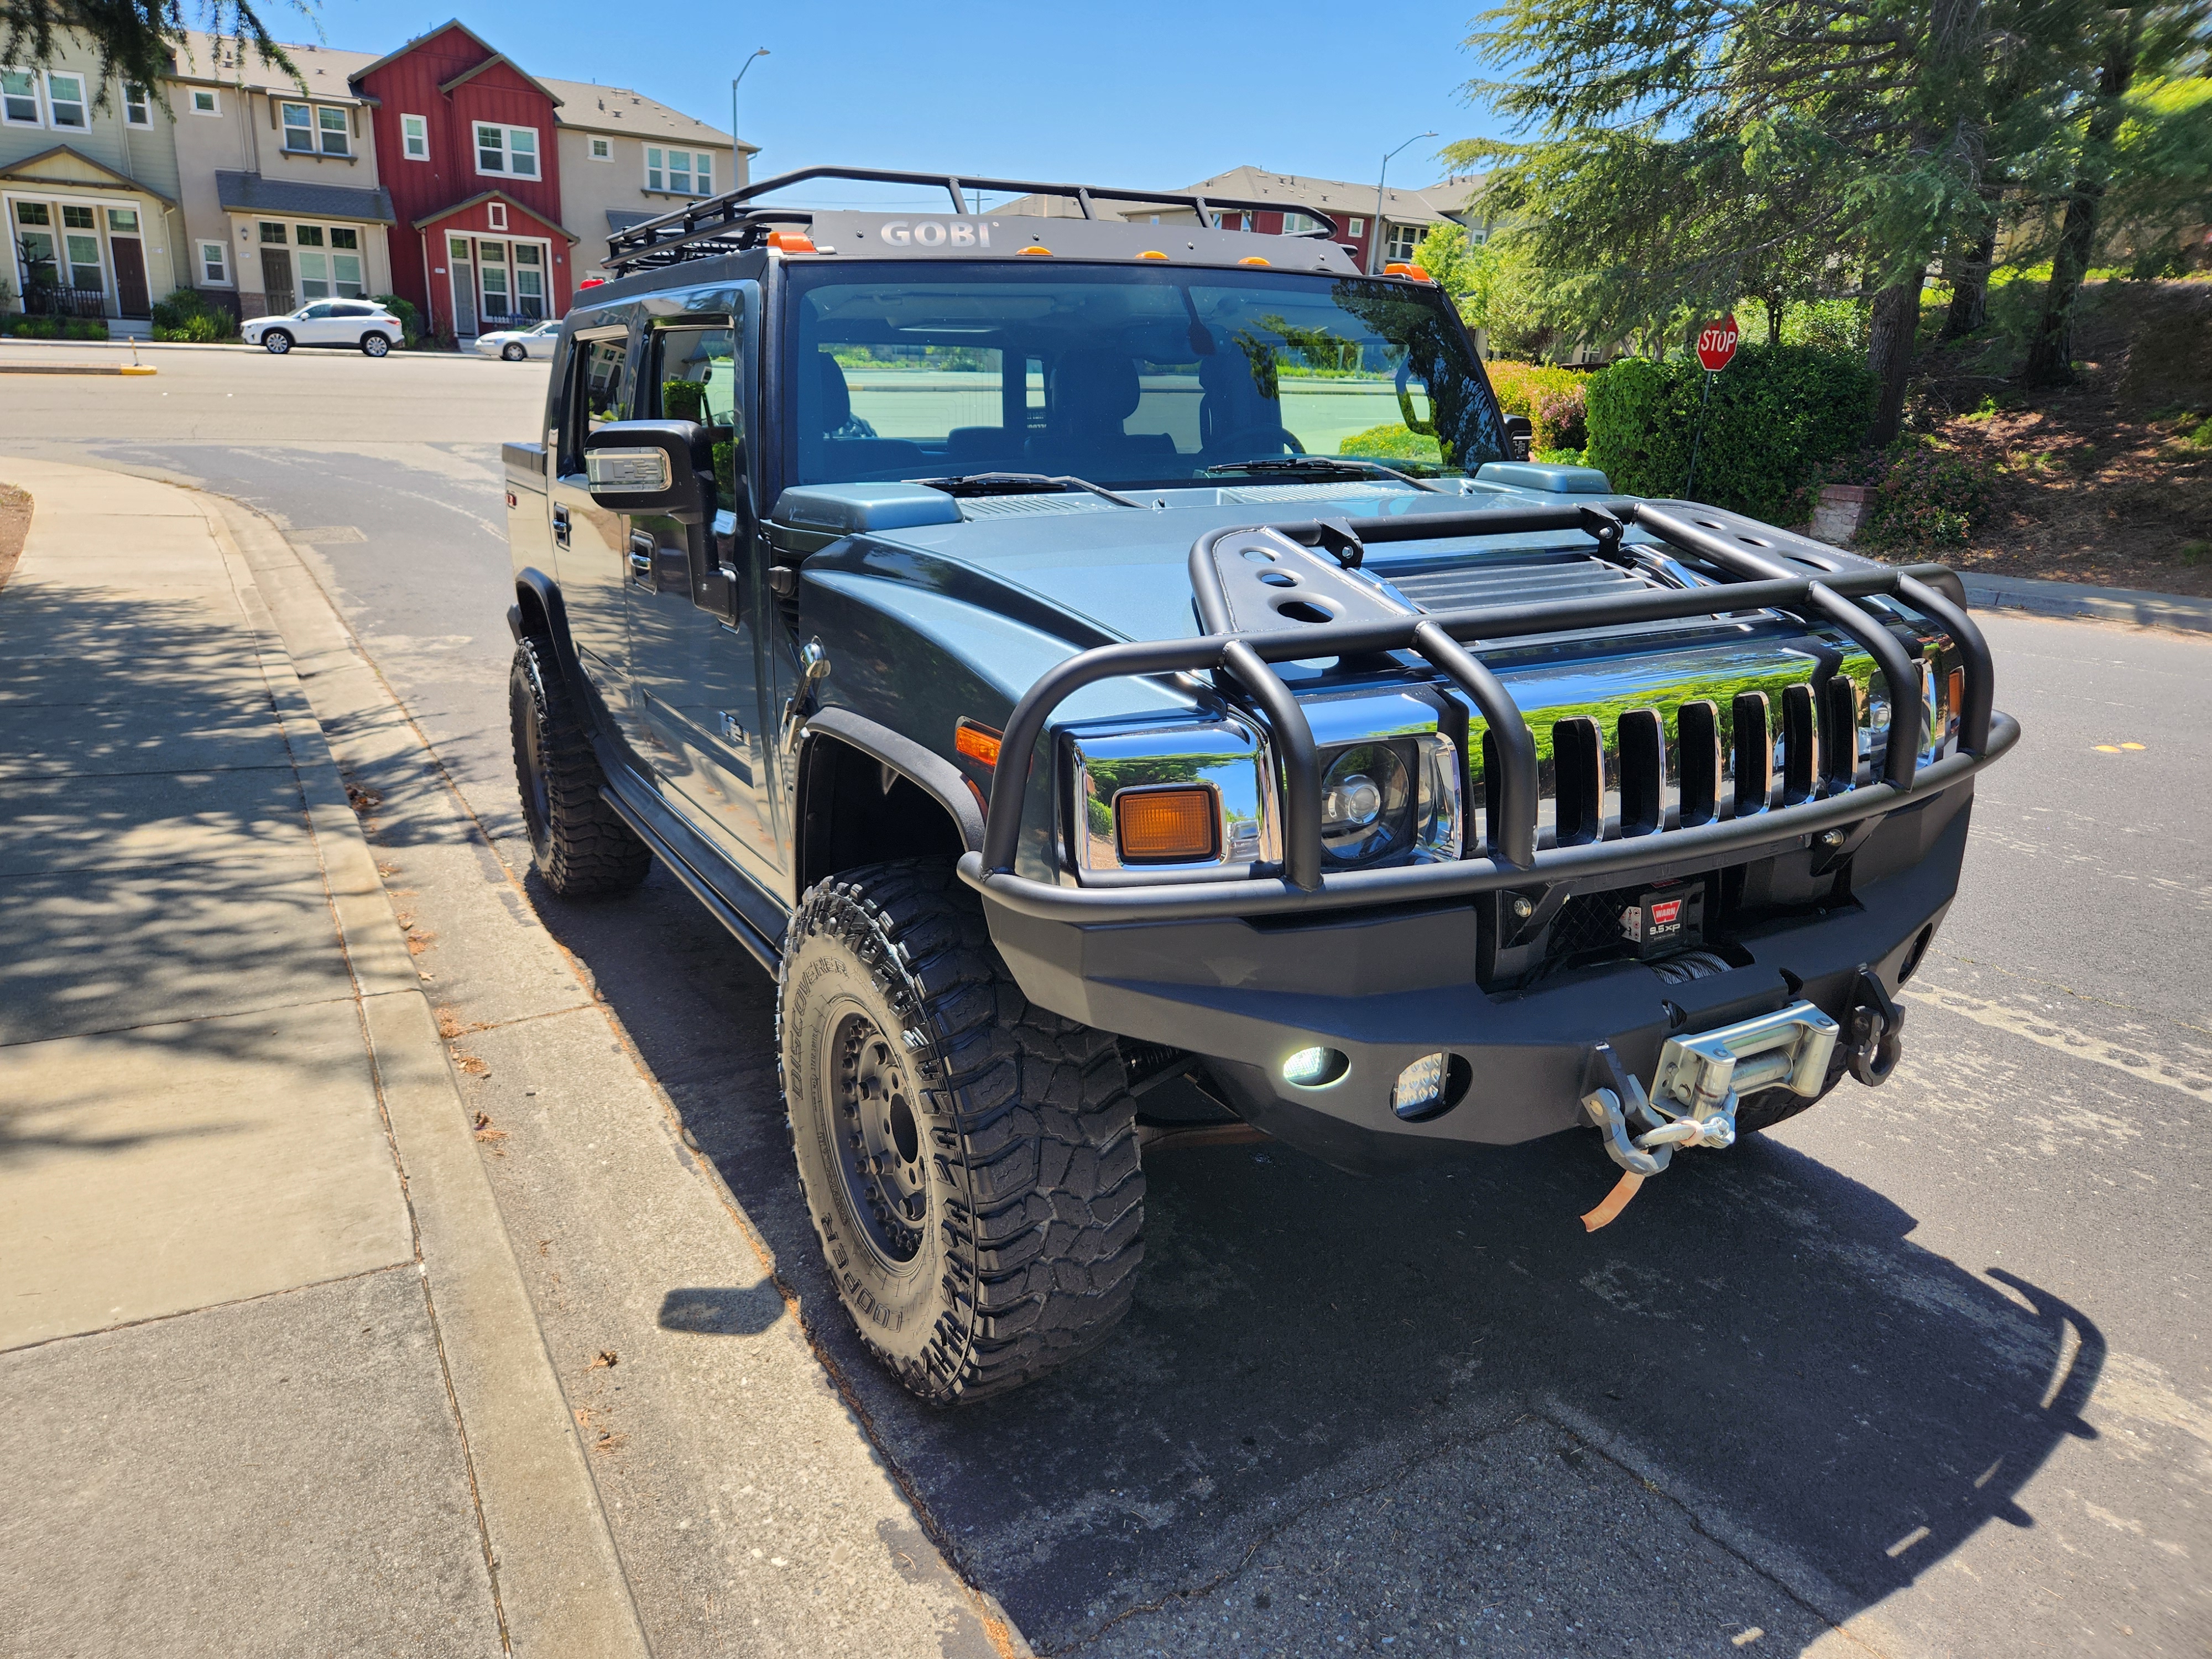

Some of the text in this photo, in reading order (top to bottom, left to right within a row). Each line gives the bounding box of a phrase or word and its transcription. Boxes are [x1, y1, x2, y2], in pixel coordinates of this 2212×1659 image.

[881, 221, 991, 248] GOBI
[1700, 329, 1736, 352] STOP
[1656, 907, 1676, 918] WARN
[790, 956, 850, 1100] DISCOVERER
[821, 1212, 903, 1333] COOPER
